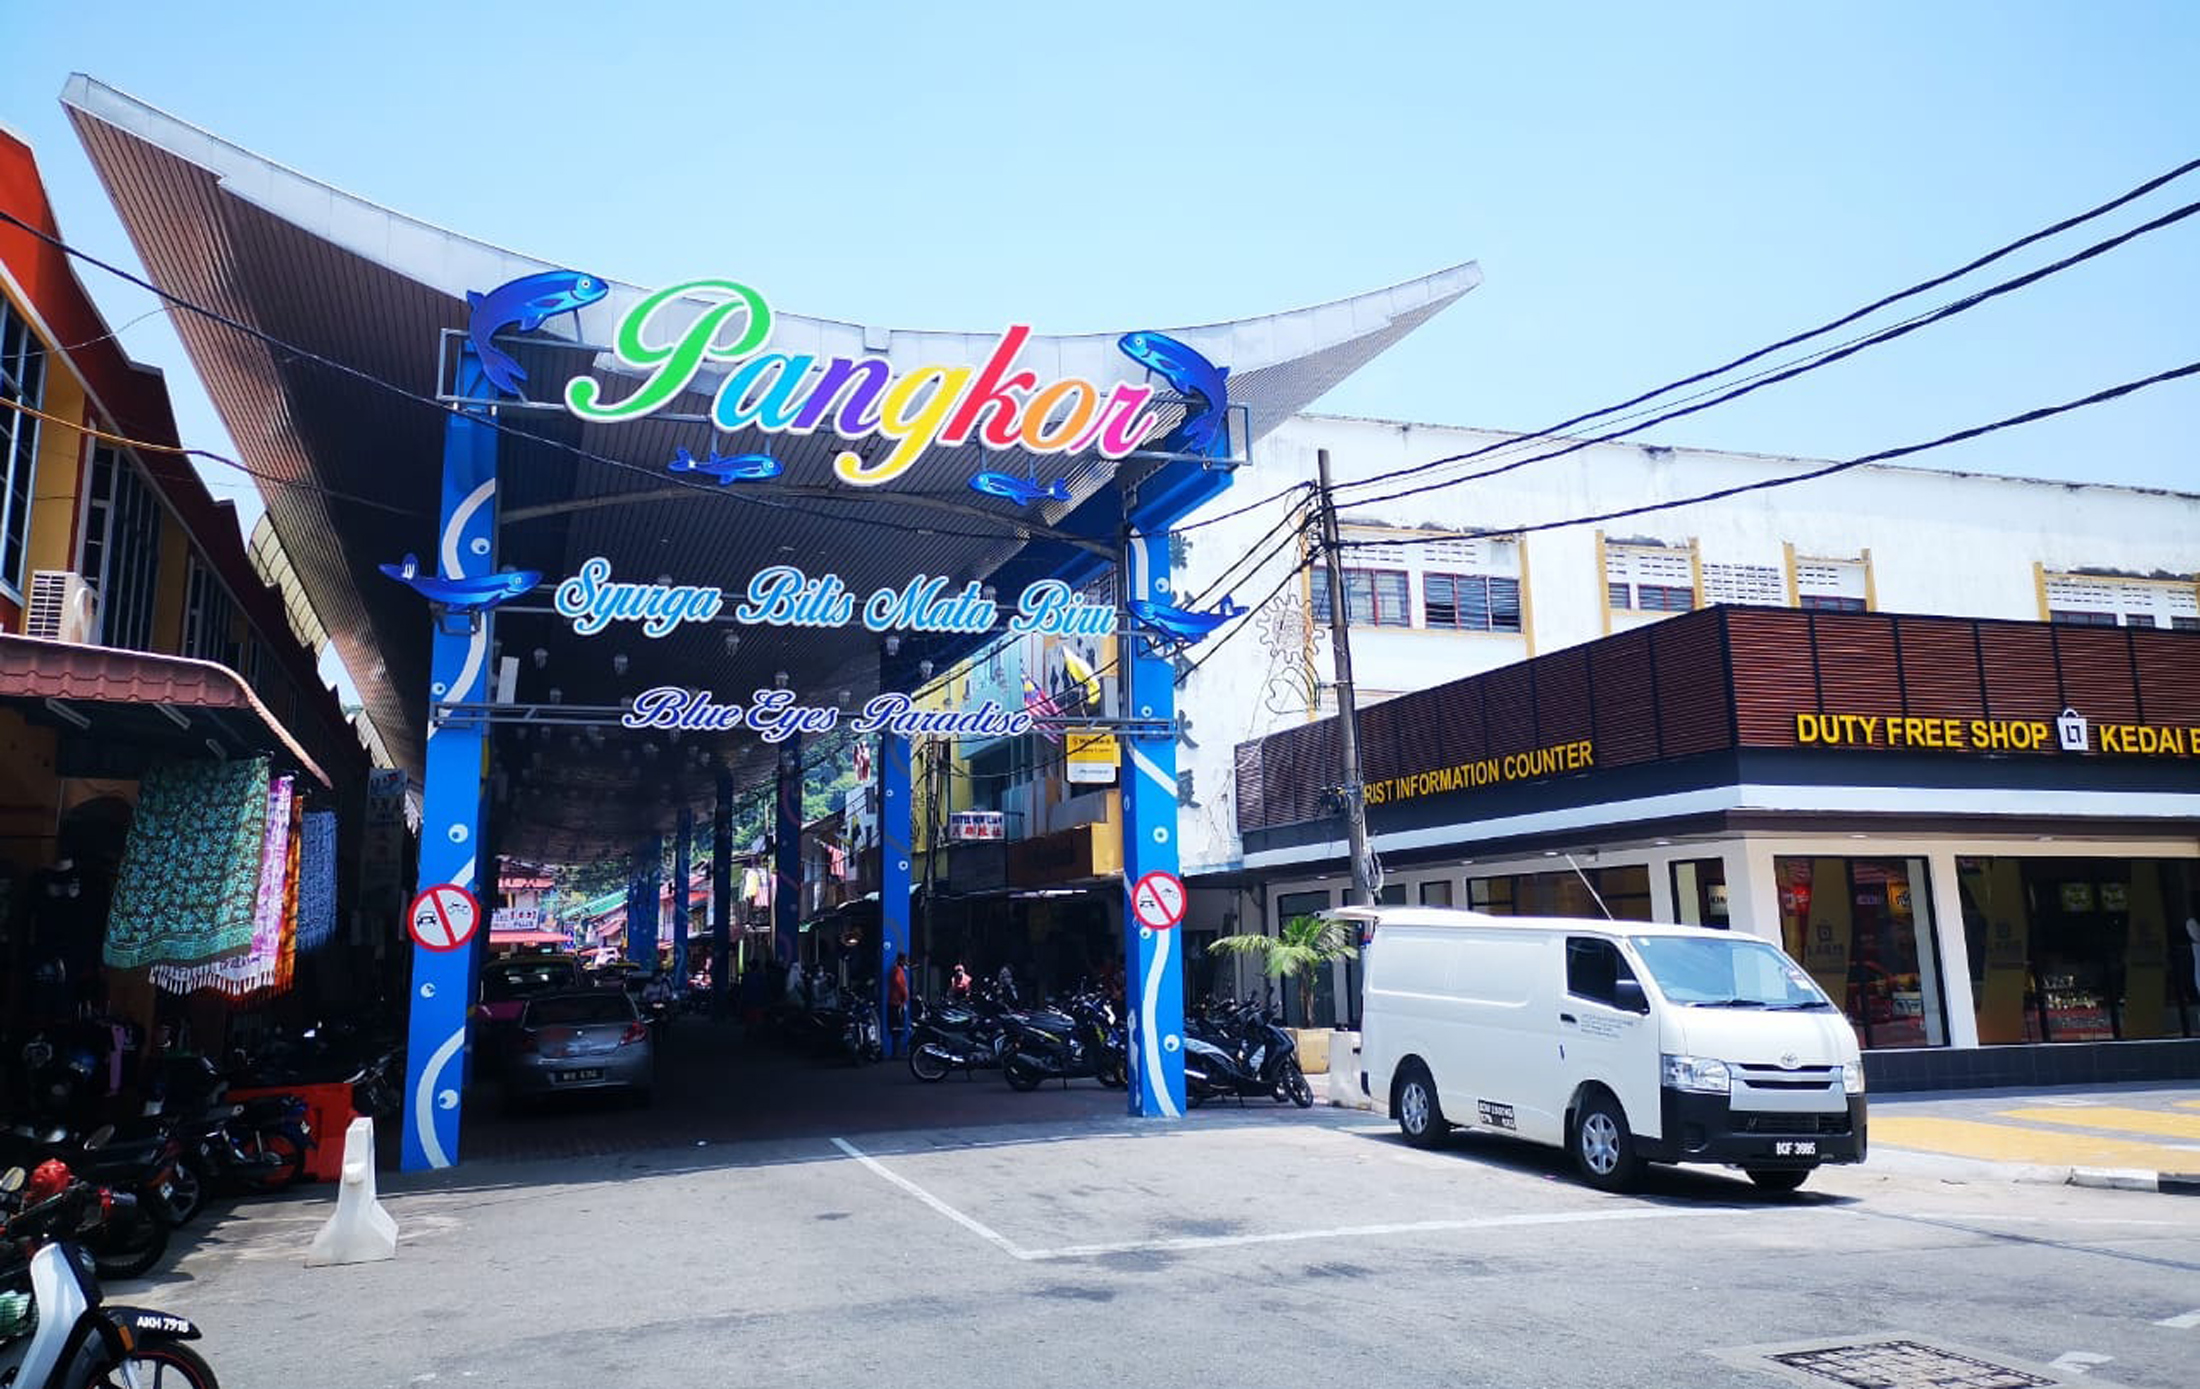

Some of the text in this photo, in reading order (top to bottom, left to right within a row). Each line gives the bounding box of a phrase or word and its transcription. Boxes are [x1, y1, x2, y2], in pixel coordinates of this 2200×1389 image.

[565, 278, 1159, 486] Pangkor
[555, 557, 1118, 637] Syurga Bilis Mata Biru
[622, 686, 1033, 743] Blue Eyes Paradise
[1796, 714, 1878, 744] DUTY
[1887, 717, 1964, 748] FREE
[1971, 720, 2048, 750] SHOP
[2100, 725, 2184, 754] KEDAI
[1395, 757, 1500, 800] INFORMATION
[1503, 740, 1594, 780] COUNTER
